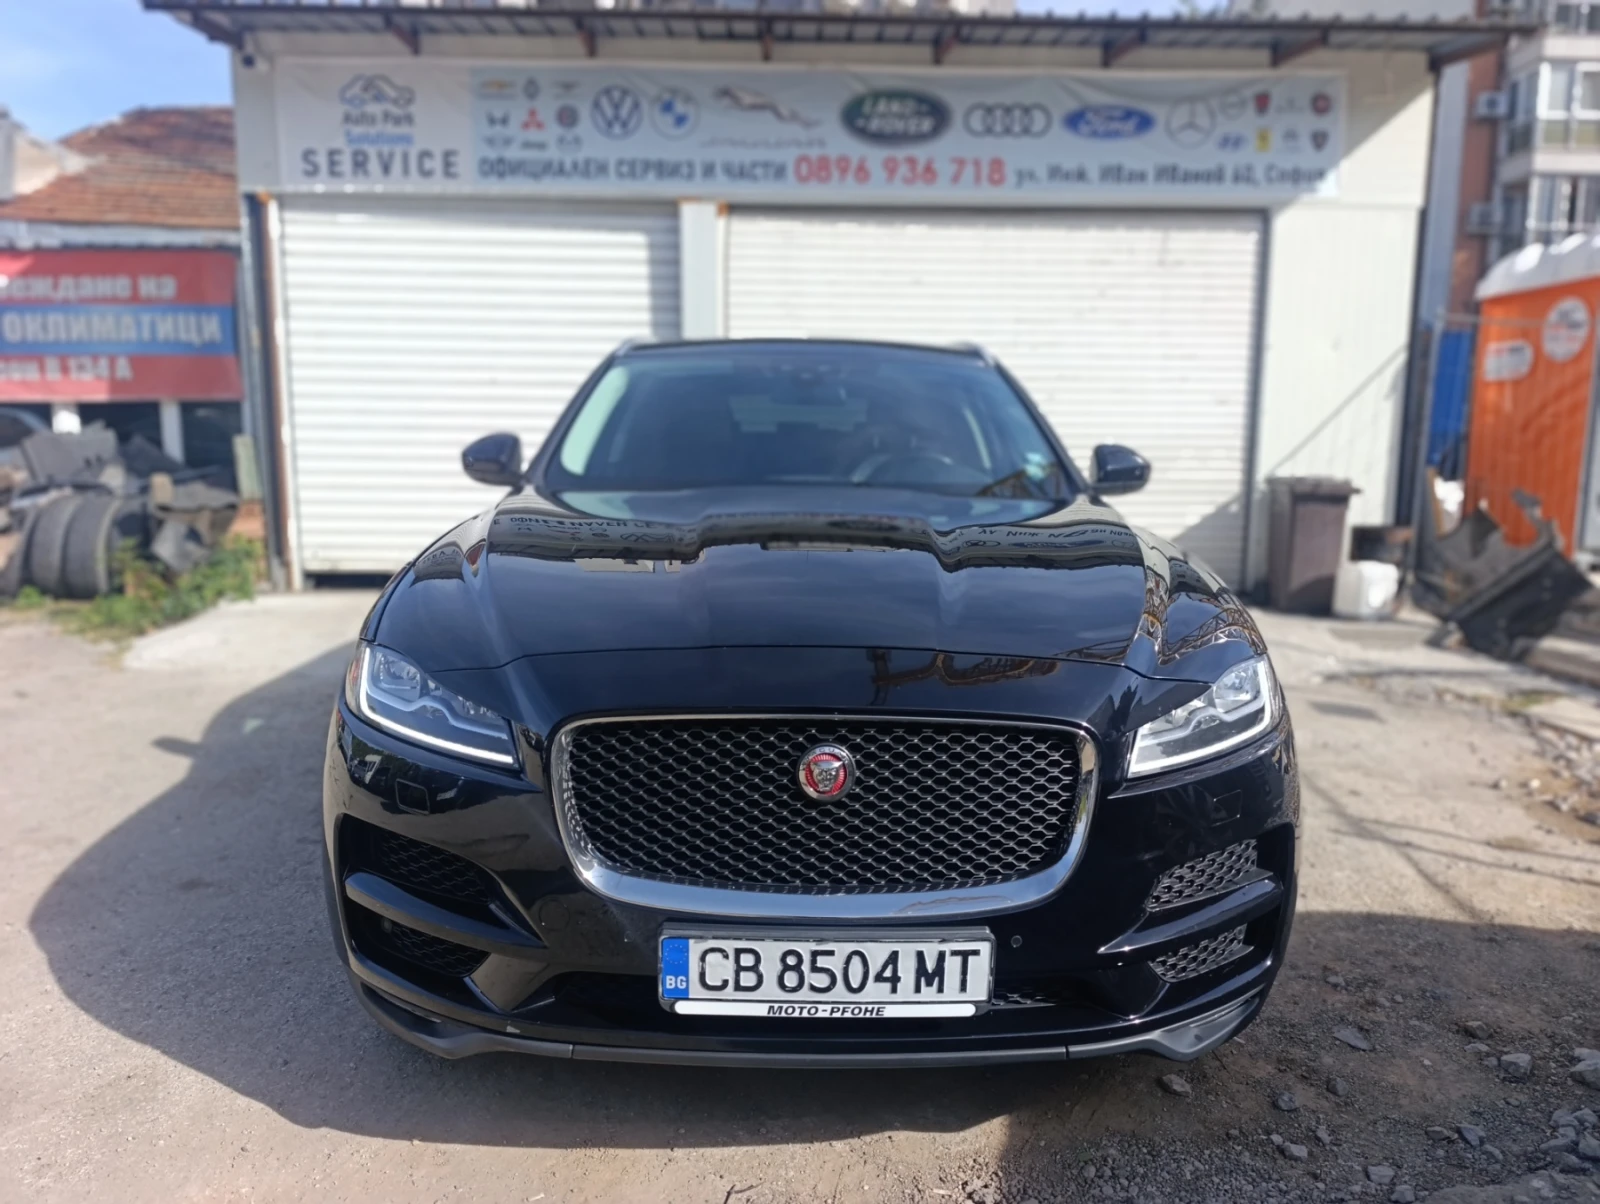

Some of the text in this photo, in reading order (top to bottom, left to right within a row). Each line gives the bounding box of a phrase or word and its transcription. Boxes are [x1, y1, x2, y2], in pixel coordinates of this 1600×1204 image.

[342, 109, 416, 127] Auto Park
[862, 96, 918, 115] LAND
[866, 115, 936, 136] ROVER
[301, 148, 460, 179] SERVICE
[477, 155, 610, 182] ОФИЦИАЛЕН
[614, 156, 696, 182] СЕРВИЗ
[701, 158, 718, 181] И
[720, 158, 788, 182] ЧАСТИ
[793, 153, 871, 186] 0896
[881, 154, 939, 187] 936
[948, 156, 1007, 188] 718
[2, 311, 223, 348] ОКЛИМАТИЦИ
[666, 947, 981, 995] BG CB 8504 MT
[766, 1004, 886, 1017] MOTO-PFOHE
